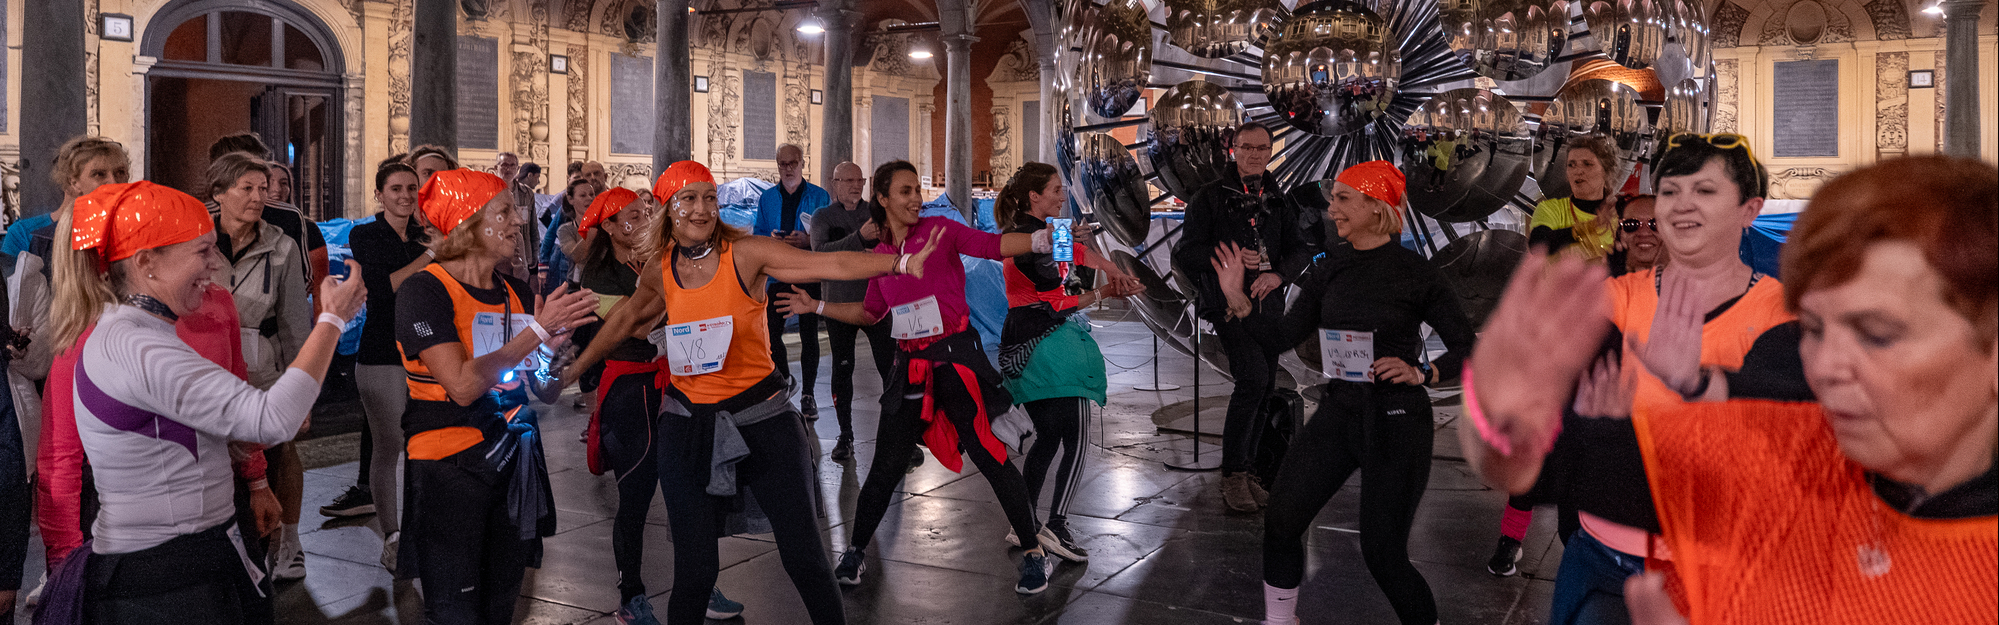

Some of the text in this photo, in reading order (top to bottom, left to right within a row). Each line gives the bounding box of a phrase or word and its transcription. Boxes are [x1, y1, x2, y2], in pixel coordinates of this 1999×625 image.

[113, 21, 122, 34] 5
[1916, 74, 1927, 84] 14
[673, 326, 690, 335] Nord
[680, 337, 706, 364] V8
